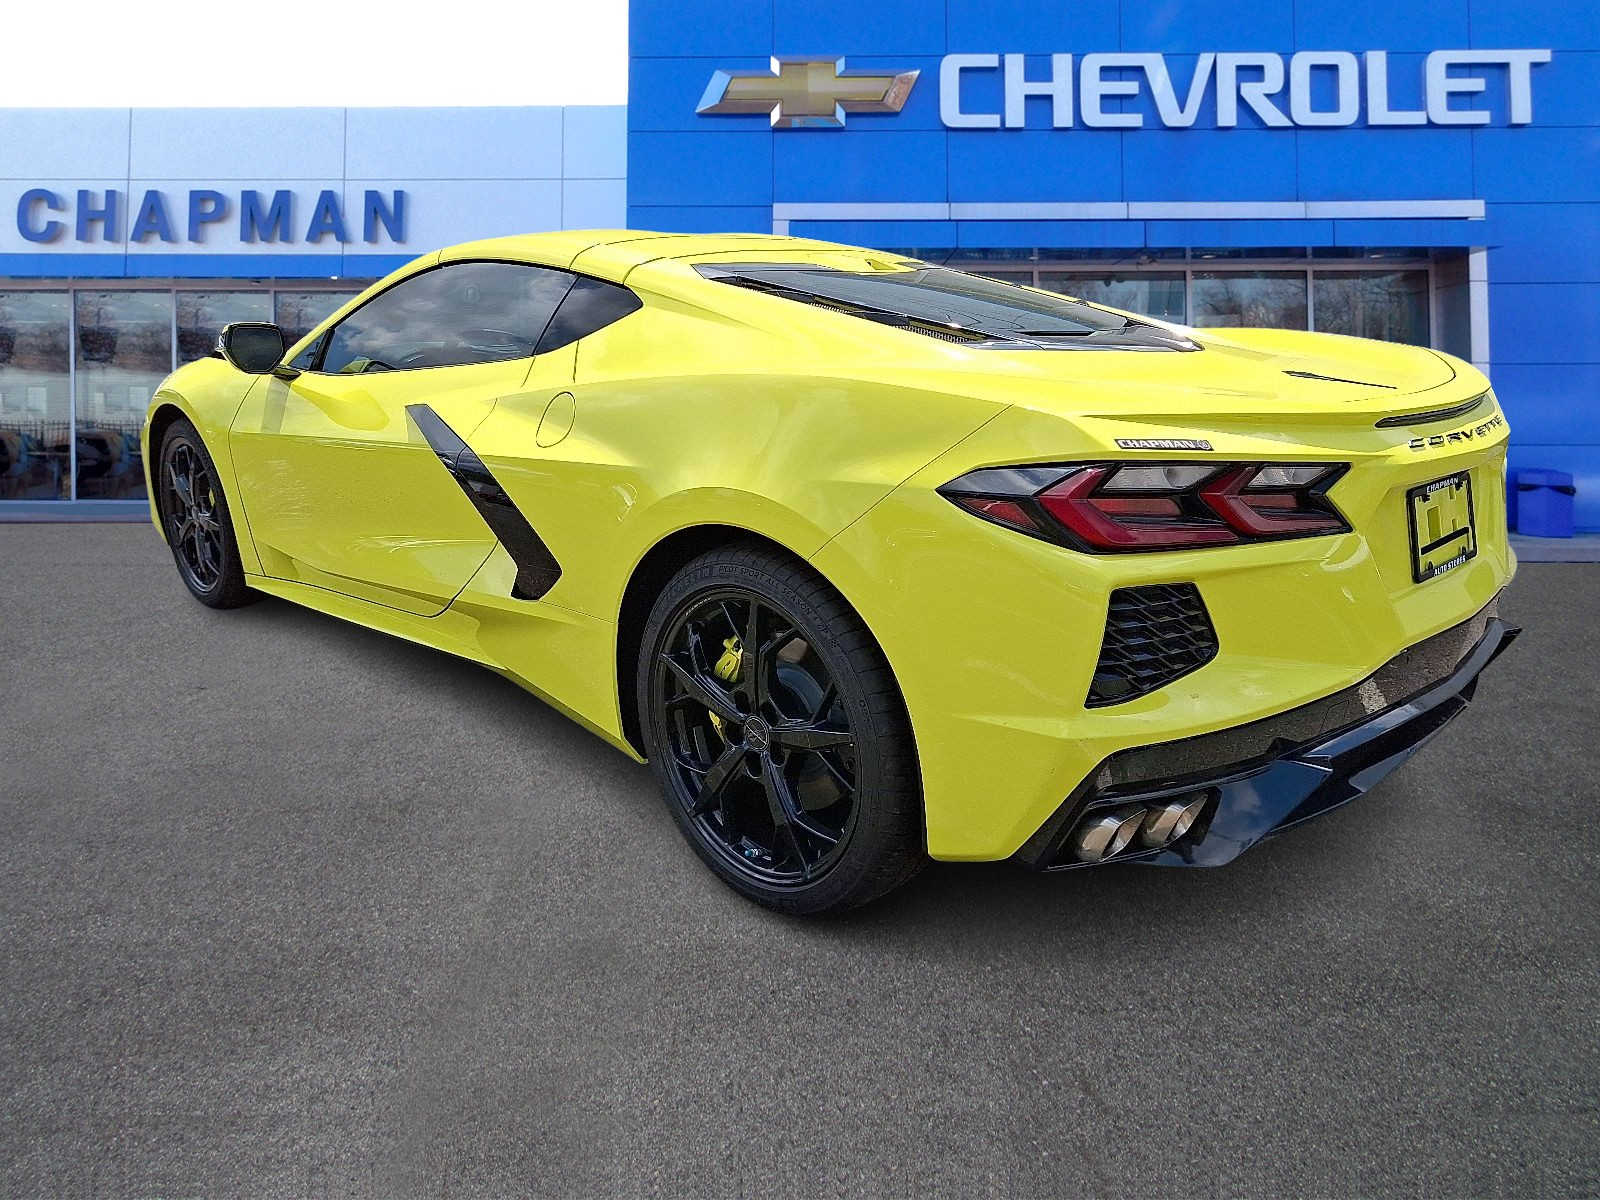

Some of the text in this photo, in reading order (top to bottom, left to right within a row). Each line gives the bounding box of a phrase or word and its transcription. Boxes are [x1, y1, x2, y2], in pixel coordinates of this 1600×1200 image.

[939, 49, 1552, 128] CHEVROLET
[16, 188, 407, 243] CHAPMAN
[1117, 439, 1197, 449] CHAPMAN
[1408, 414, 1502, 449] CORVETTE
[1426, 477, 1459, 493] CHAPMAN
